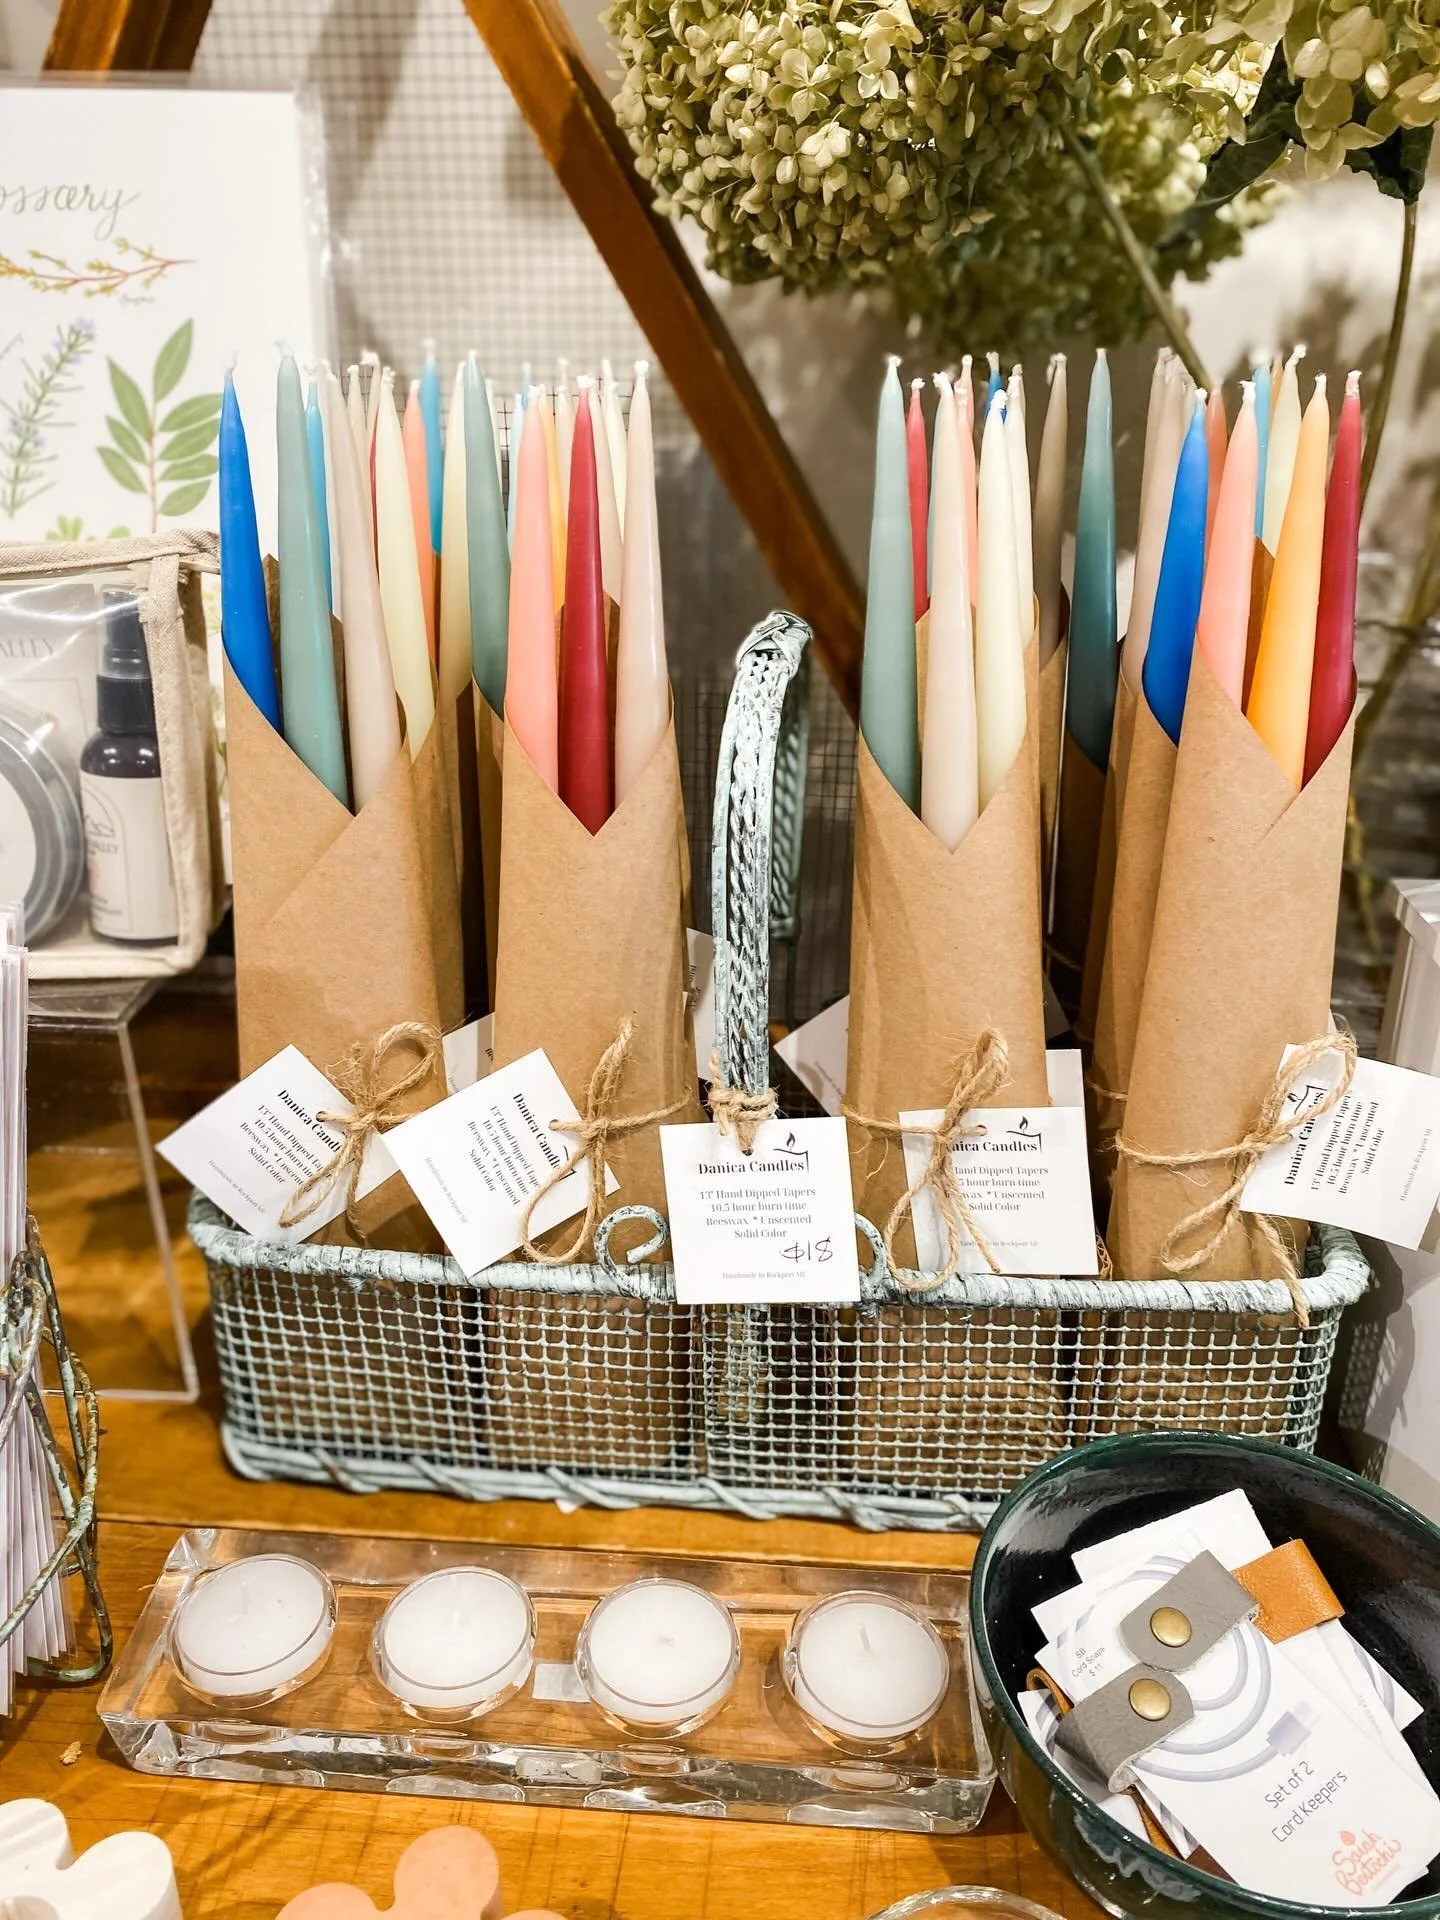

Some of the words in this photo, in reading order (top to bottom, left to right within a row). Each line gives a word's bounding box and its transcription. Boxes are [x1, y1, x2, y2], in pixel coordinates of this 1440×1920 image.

[239, 1122, 269, 1153] Beeswax
[268, 1114, 290, 1136] Hand
[287, 1134, 314, 1159] Dipped
[277, 1089, 312, 1125] Danica
[311, 1122, 342, 1152] Candl
[512, 1093, 538, 1132] Danica
[535, 1132, 560, 1168] Candle
[1284, 1143, 1306, 1184] Danica
[1298, 1092, 1324, 1140] Canes
[1331, 1145, 1347, 1167] hour
[1339, 1123, 1356, 1144] burn
[1350, 1101, 1362, 1121] time
[247, 1147, 268, 1166] Solid
[265, 1164, 285, 1183] Color
[267, 1131, 286, 1150] hour
[284, 1148, 303, 1168] burn
[467, 1121, 490, 1157] Beeswax
[492, 1163, 520, 1205] Unscented
[491, 1135, 507, 1155] hour
[503, 1155, 518, 1177] burn
[514, 1176, 528, 1194] time
[496, 1117, 515, 1140] Hand
[509, 1140, 531, 1169] Dipped
[526, 1169, 540, 1187] Tape
[946, 1141, 980, 1152] nica
[983, 1140, 1038, 1152] Candles
[1314, 1152, 1330, 1176] Hand
[1323, 1120, 1341, 1151] Dipped
[1337, 1158, 1359, 1193] Beeswax
[1354, 1101, 1379, 1147] Unscented
[1360, 1152, 1375, 1174] Solid
[1368, 1127, 1384, 1151] Color
[469, 1148, 485, 1170] Solid
[480, 1169, 496, 1191] Color
[698, 1162, 746, 1174] Danica
[749, 1160, 805, 1172] Candles
[966, 1177, 990, 1187] hour
[992, 1177, 1016, 1187] burn
[1018, 1177, 1040, 1186] time
[979, 1166, 1013, 1177] Dipped
[1016, 1166, 1049, 1176] Tapers
[711, 1203, 730, 1212] 10.5
[733, 1202, 756, 1212] hour
[758, 1202, 783, 1211] burn
[785, 1201, 807, 1210] time
[716, 1189, 743, 1199] Hand
[746, 1188, 780, 1200] Dipped
[783, 1188, 816, 1197] Tapers
[968, 1202, 993, 1212] Solid
[995, 1202, 1021, 1211] Color
[994, 1190, 1045, 1200] Unscented
[706, 1217, 749, 1226] Beeswax
[760, 1215, 812, 1225] Unscented
[734, 1229, 759, 1239] Solid
[761, 1229, 788, 1238] Color
[780, 1236, 834, 1263] $18
[1264, 1784, 1291, 1808] Set
[1287, 1768, 1303, 1788] of
[1298, 1760, 1314, 1775] 2
[1271, 1809, 1304, 1842] Cord
[1297, 1771, 1347, 1816] Keepers
